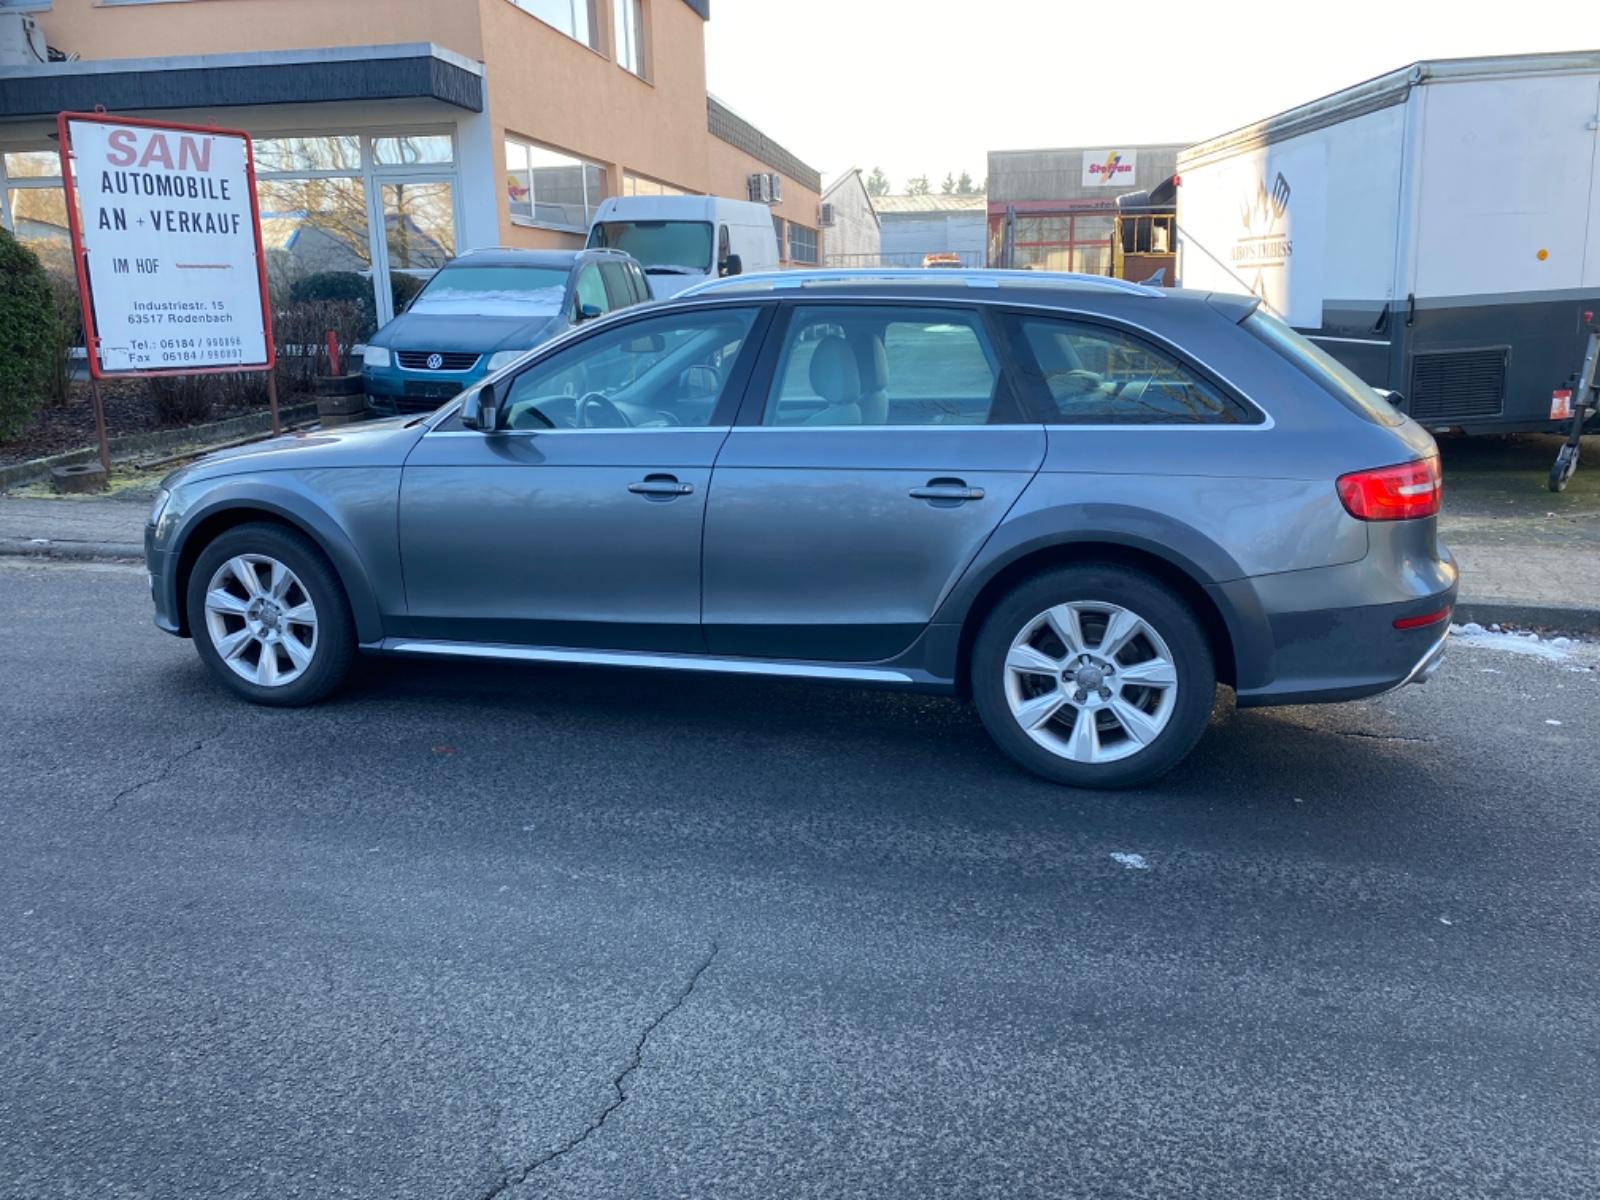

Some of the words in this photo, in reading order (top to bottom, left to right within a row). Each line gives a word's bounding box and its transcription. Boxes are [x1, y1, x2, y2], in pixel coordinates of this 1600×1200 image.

[106, 130, 212, 172] SAN
[102, 171, 230, 200] AUTOMOBILE
[99, 207, 127, 231] AN
[150, 210, 240, 234] VERKAUF
[112, 258, 129, 273] IM
[136, 258, 159, 274] HOF
[134, 301, 207, 311] Industriestr.
[212, 301, 225, 311] 15
[128, 314, 163, 324] 63517
[168, 314, 233, 323] Rodenbach
[160, 339, 194, 349] 06184
[129, 353, 151, 363] Fax
[162, 352, 196, 361] 06184
